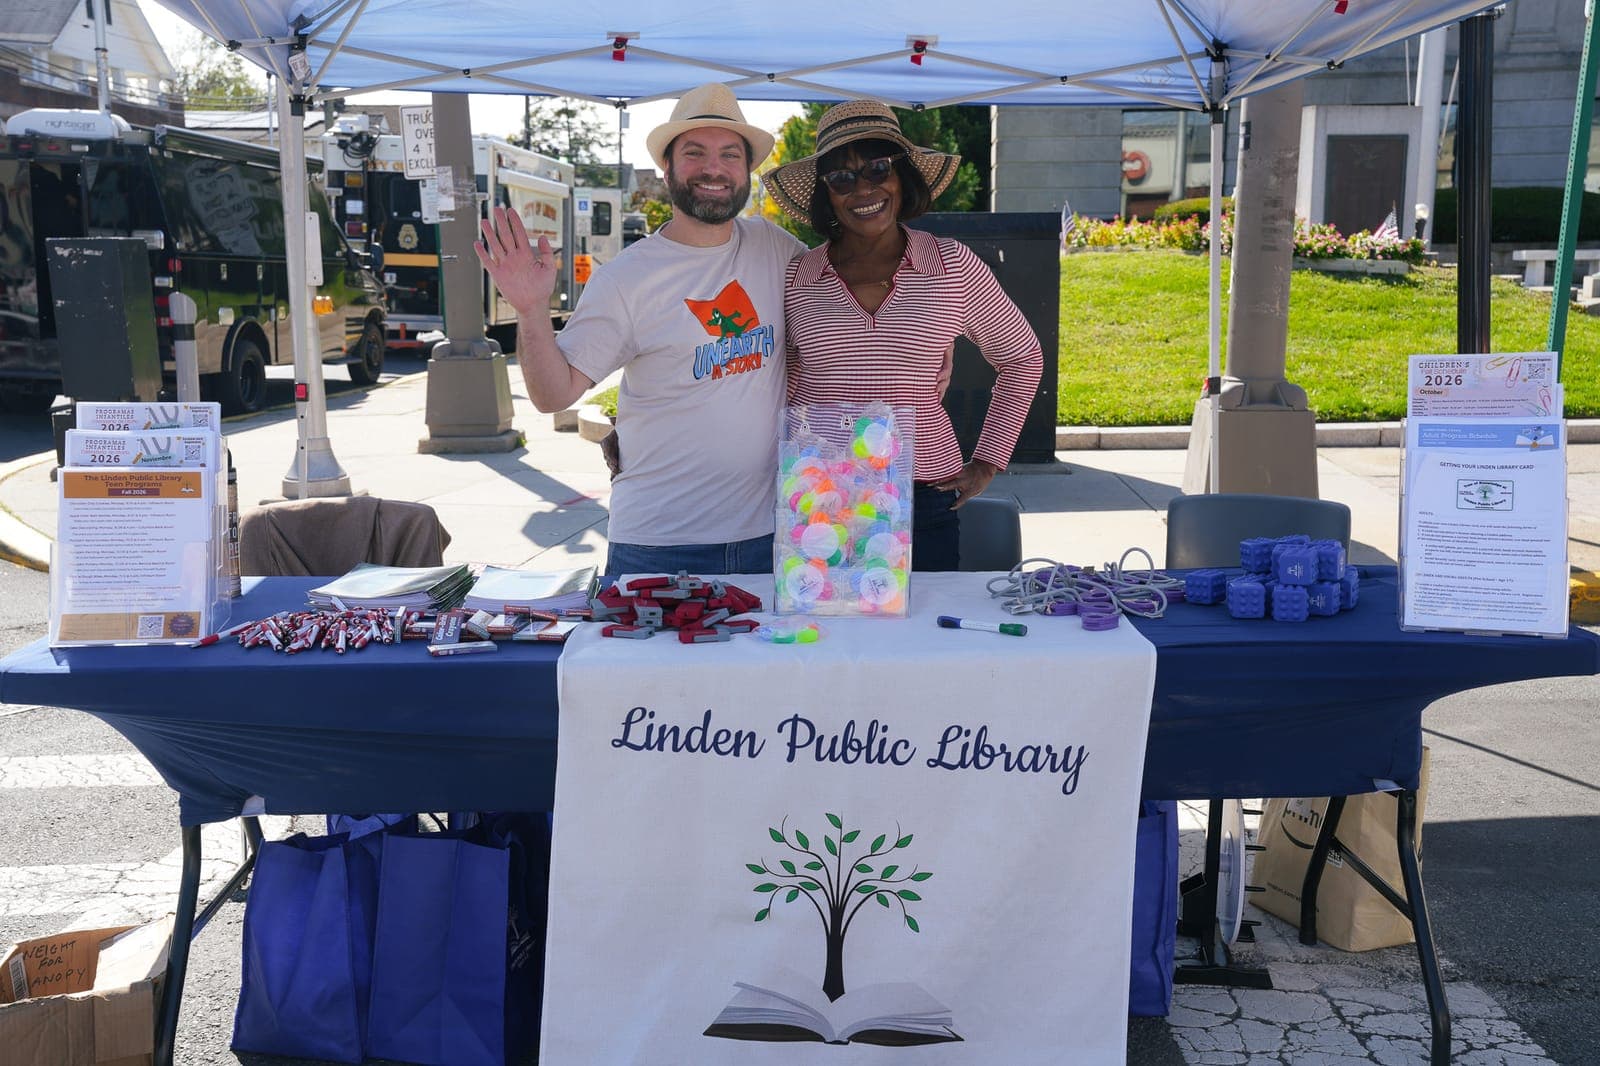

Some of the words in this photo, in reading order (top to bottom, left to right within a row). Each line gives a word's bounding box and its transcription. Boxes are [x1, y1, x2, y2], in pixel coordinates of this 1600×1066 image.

[407, 113, 433, 124] TRUC
[415, 128, 434, 139] OVE
[413, 144, 420, 154] 4
[693, 324, 775, 380] UNEARTH
[711, 364, 723, 380] A
[725, 352, 762, 376] STORY
[1418, 361, 1470, 369] CHILDREN'S
[1424, 375, 1463, 386] 2026
[91, 455, 120, 463] 2026
[125, 481, 163, 489] Programs
[611, 706, 766, 759] Linden
[777, 713, 917, 766] Public
[926, 724, 1090, 796] Library
[38, 956, 63, 970] FOR
[32, 968, 86, 986] ANOPY
